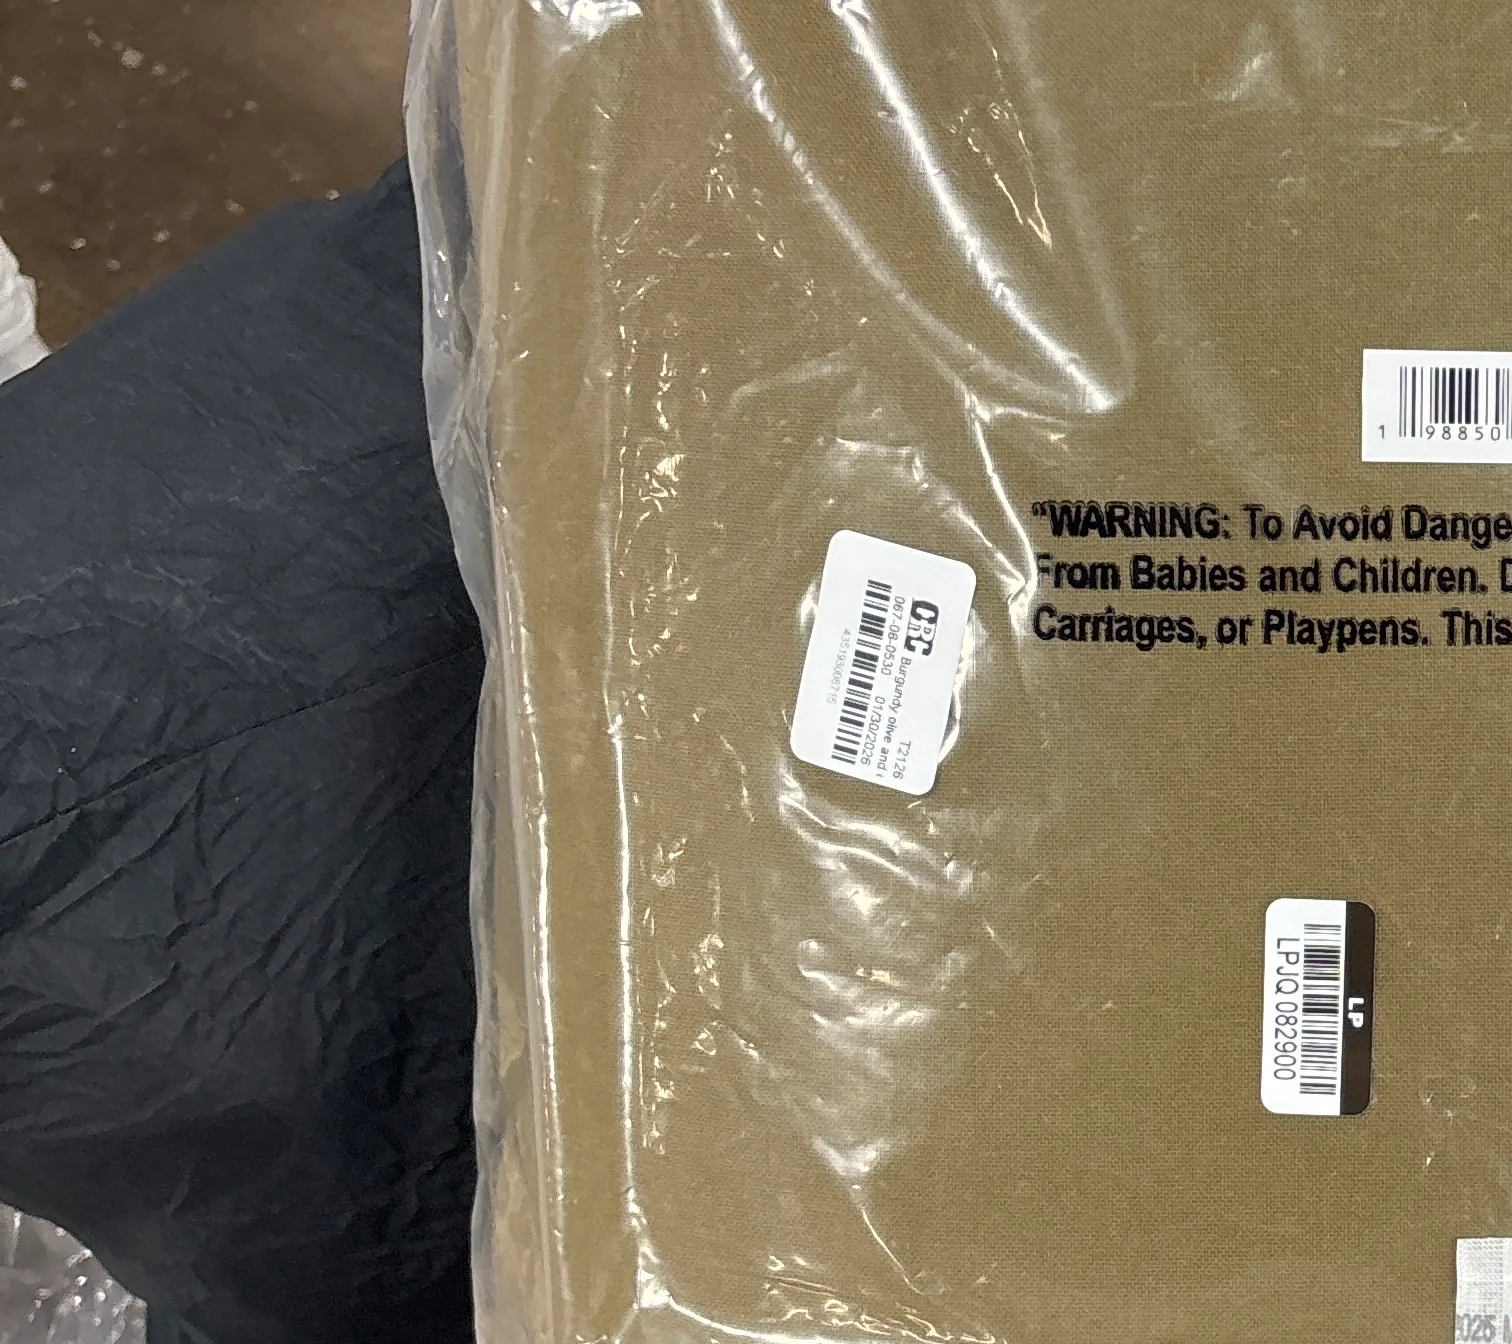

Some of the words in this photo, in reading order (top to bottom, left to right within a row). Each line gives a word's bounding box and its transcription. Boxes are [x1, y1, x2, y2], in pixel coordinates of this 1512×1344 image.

[1425, 425, 1501, 441] 98850
[1244, 504, 1284, 540] To
[1293, 506, 1392, 541] Avoid
[1037, 553, 1120, 591] From
[1130, 553, 1246, 592] Babies
[1259, 555, 1322, 592] and
[1333, 555, 1489, 594] Children.
[881, 596, 906, 676] 067-08-0530
[1033, 603, 1207, 651] Carriages,
[1216, 616, 1253, 646] or
[1262, 608, 1430, 654] Playpens.
[893, 656, 912, 715] Burgundy
[860, 696, 886, 765] 01/30/2026
[883, 715, 898, 744] olive
[877, 747, 890, 772] and
[892, 740, 912, 781] T2126
[1275, 937, 1300, 995] LPJQ
[1347, 997, 1365, 1028] LP
[1273, 1001, 1299, 1081] 082900
